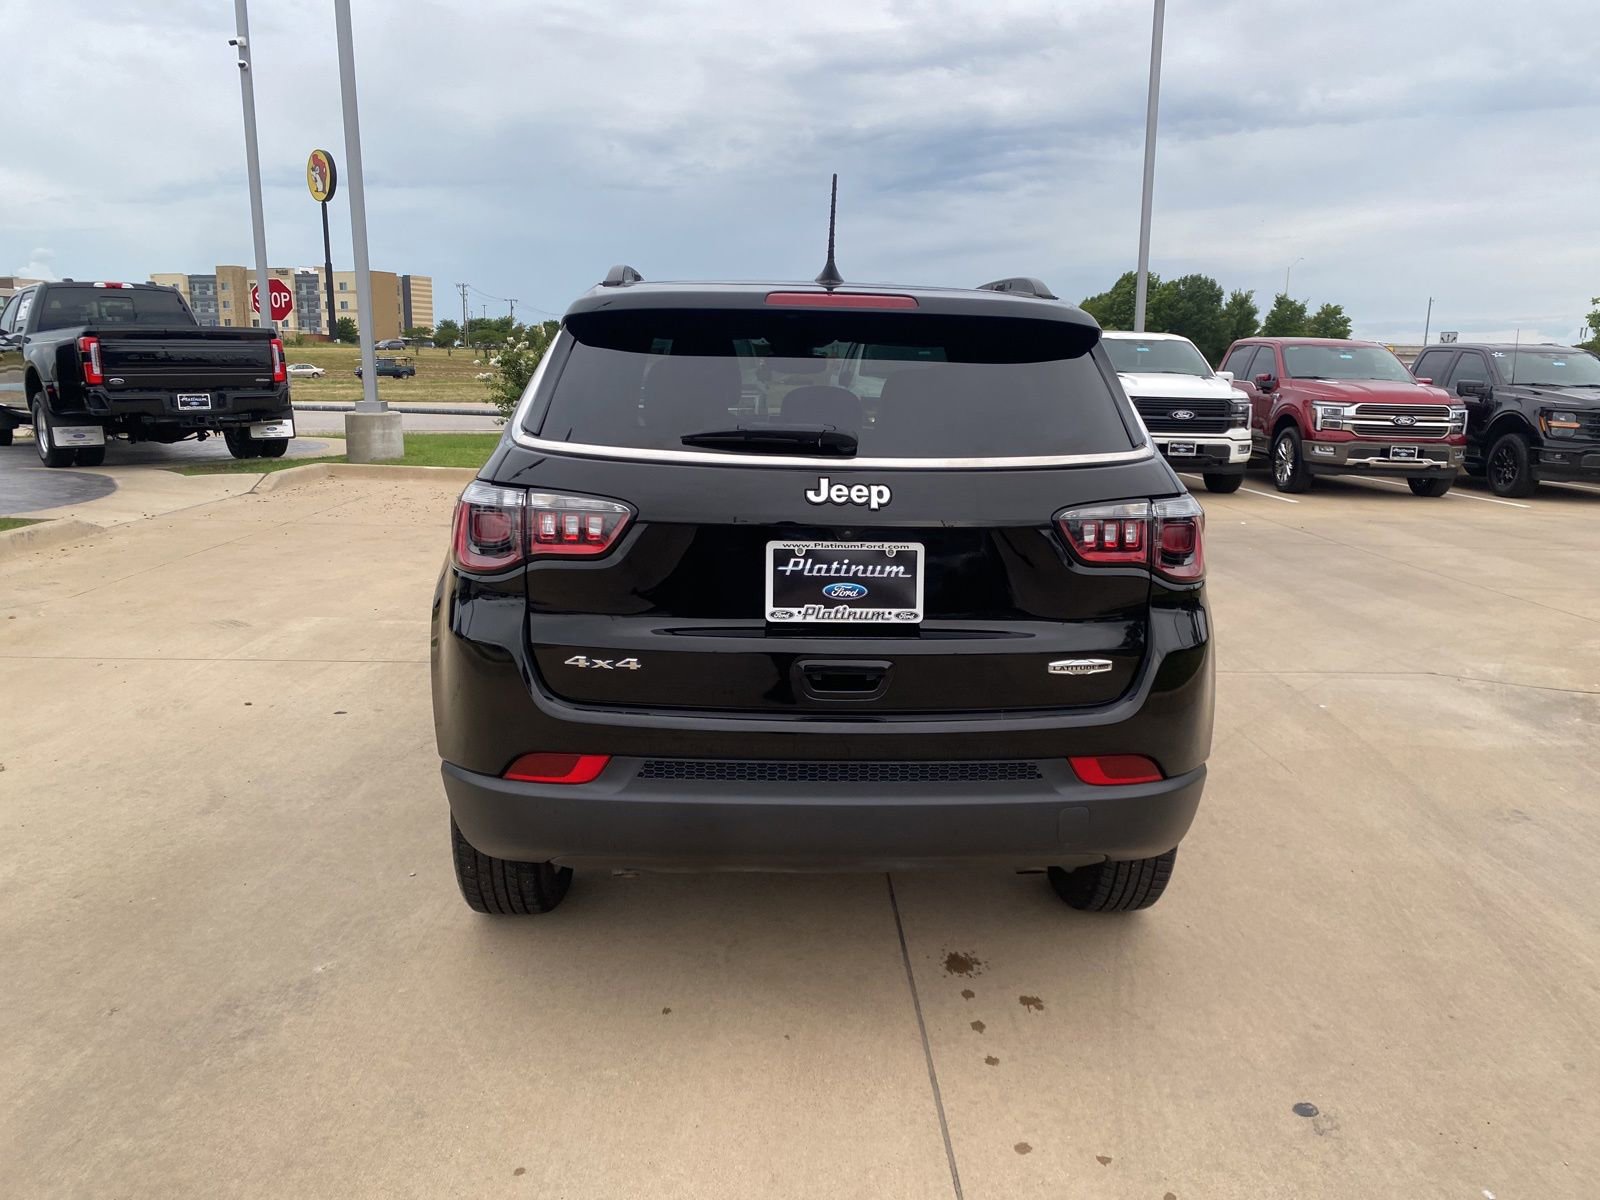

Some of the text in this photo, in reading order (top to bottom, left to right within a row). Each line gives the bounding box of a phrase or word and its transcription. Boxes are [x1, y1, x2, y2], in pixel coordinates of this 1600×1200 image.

[255, 292, 289, 308] SOP
[805, 477, 891, 510] Jeep
[782, 542, 910, 550] www.PlatinumFord.com
[777, 558, 912, 578] Platinum
[831, 584, 859, 598] Ford
[802, 605, 891, 621] Platinum
[564, 655, 641, 670] 4x4
